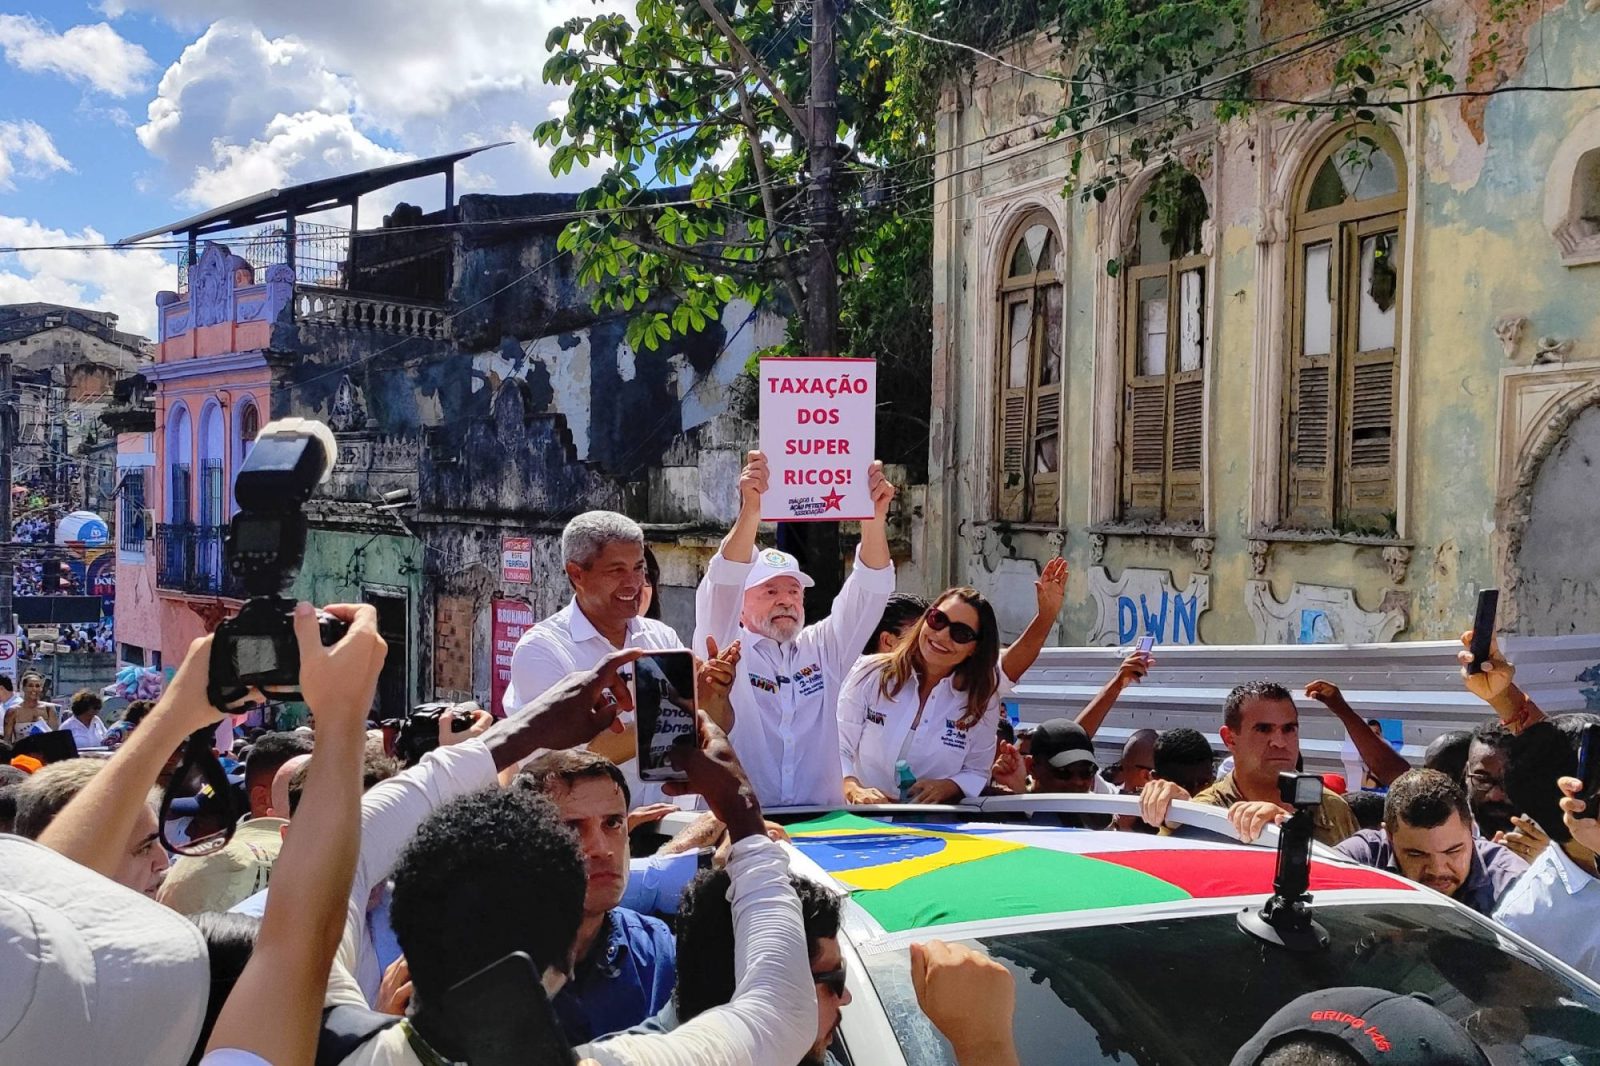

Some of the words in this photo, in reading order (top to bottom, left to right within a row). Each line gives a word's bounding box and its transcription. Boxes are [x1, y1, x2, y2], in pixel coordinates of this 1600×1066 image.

[768, 374, 868, 398] TAXAÇÃO
[797, 408, 840, 425] DOS
[785, 439, 850, 455] SUPER
[784, 469, 852, 485] RICOS!
[1118, 591, 1197, 645] DWN
